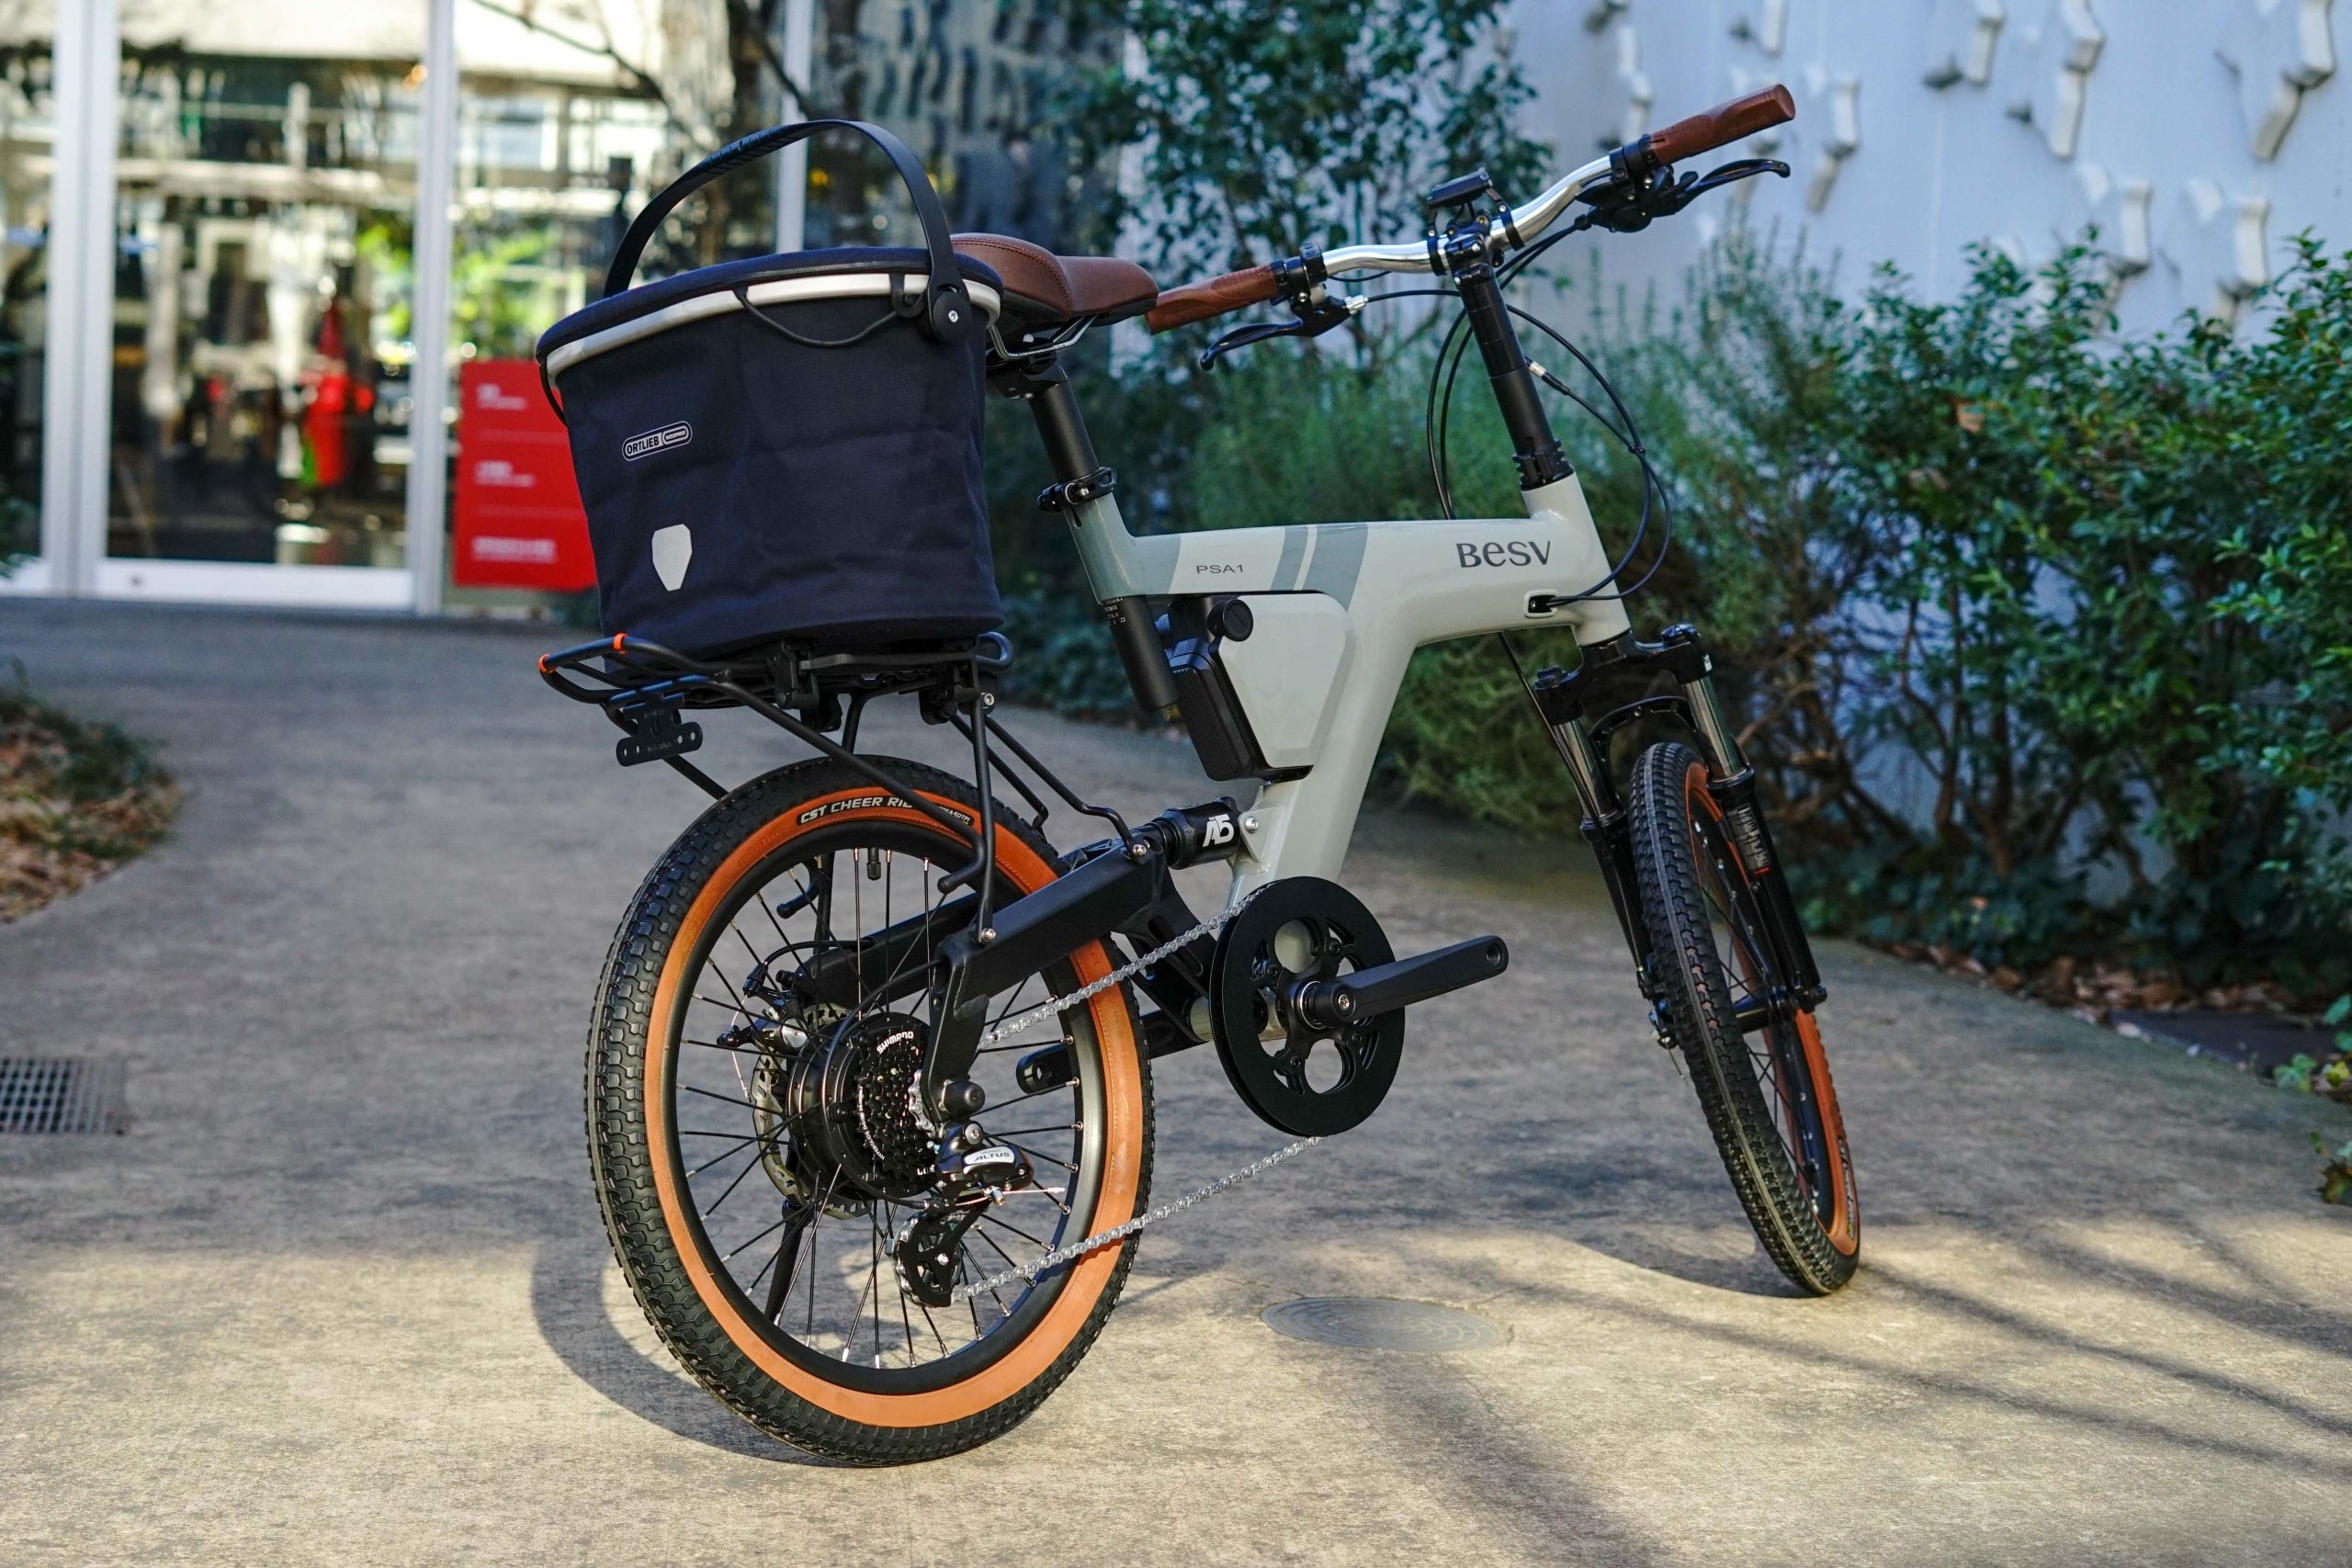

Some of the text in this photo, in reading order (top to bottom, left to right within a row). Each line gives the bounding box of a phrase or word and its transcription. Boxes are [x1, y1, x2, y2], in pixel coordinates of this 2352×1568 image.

[627, 435, 660, 455] ORTLIEB
[1196, 564, 1243, 574] PSA1
[800, 805, 828, 824] CST
[831, 796, 884, 813] CHEER
[876, 1031, 914, 1054] SHIMANO
[974, 1152, 1010, 1162] ALTUS
